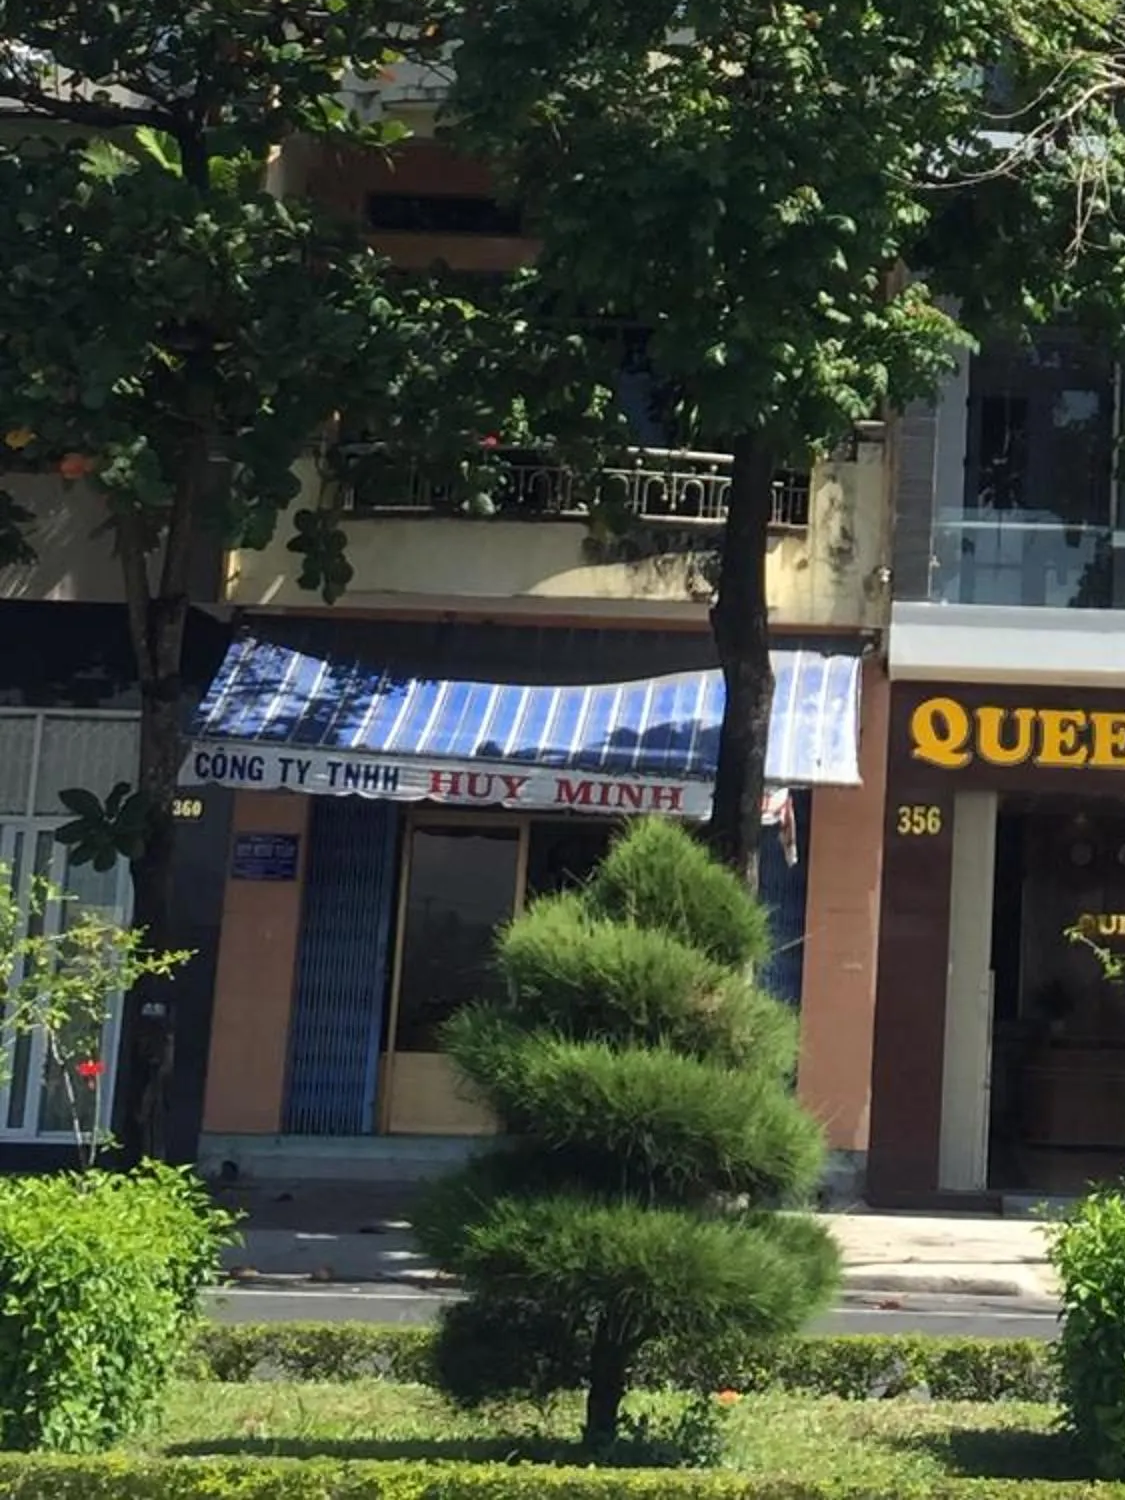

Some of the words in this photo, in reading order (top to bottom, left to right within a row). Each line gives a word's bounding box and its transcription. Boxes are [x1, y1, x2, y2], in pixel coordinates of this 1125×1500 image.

[194, 747, 265, 781] CÔNG
[278, 757, 312, 785] TY
[326, 761, 400, 792] TNHH
[429, 769, 531, 800] HUY
[554, 778, 684, 811] MINH
[172, 799, 203, 817] 360
[897, 805, 941, 835] 356
